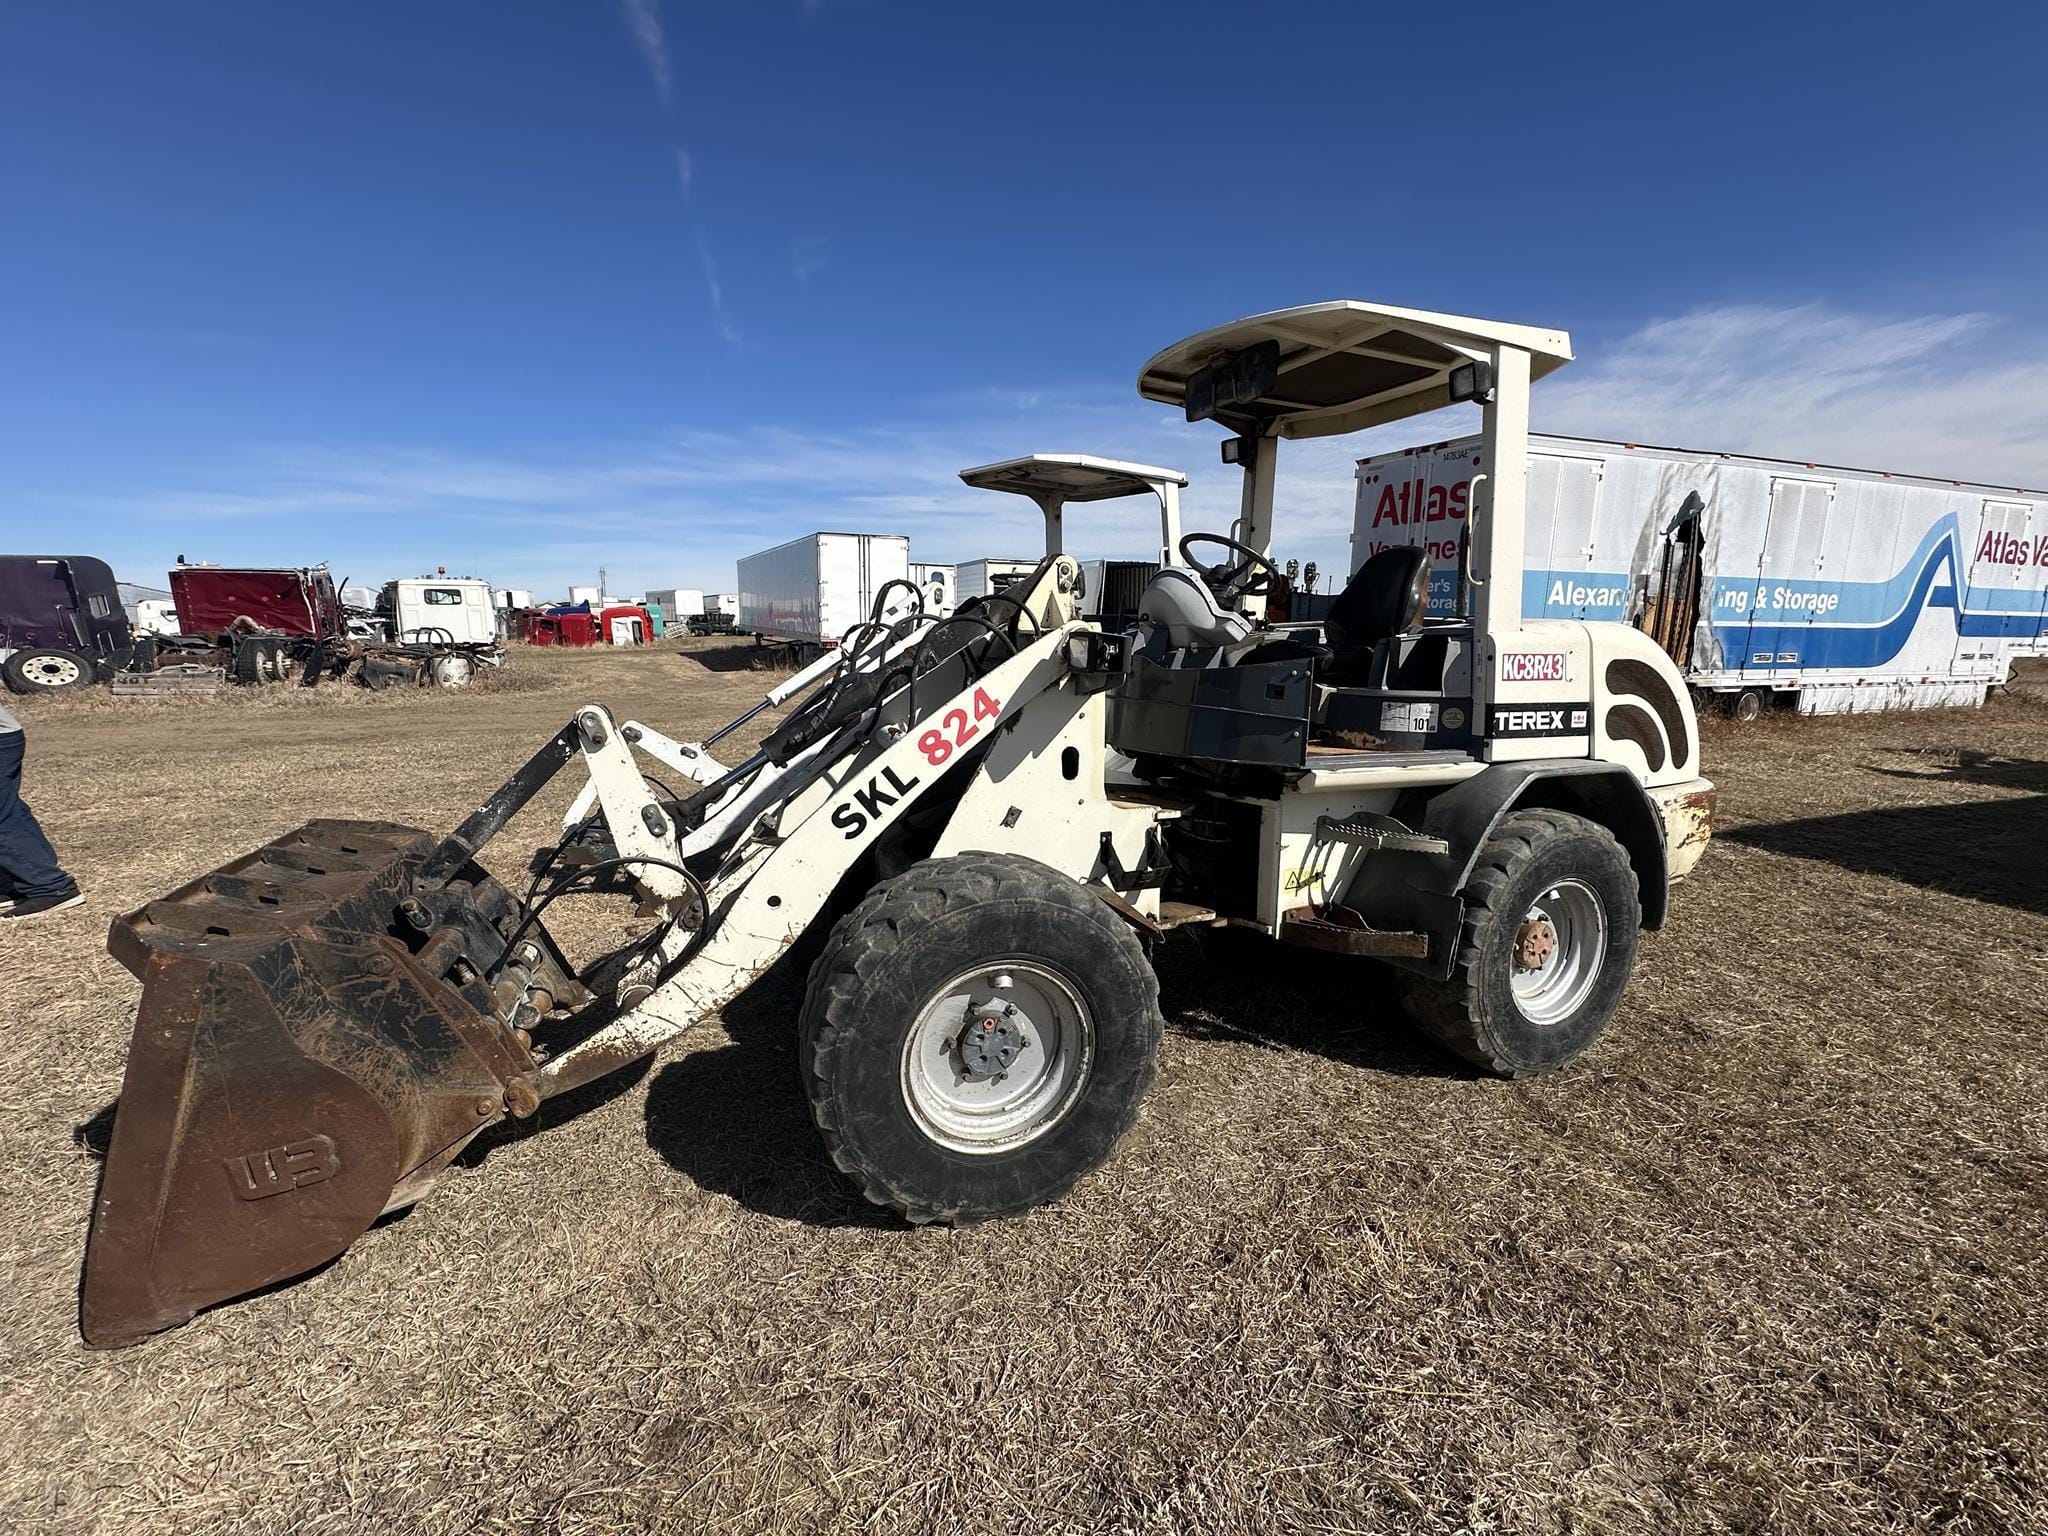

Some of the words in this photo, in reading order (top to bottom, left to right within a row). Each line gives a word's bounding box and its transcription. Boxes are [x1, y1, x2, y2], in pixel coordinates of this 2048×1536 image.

[1372, 479, 1470, 528] Atlas
[1976, 530, 2030, 566] Atlas
[1754, 586, 1768, 609] &
[1772, 586, 1839, 614] Storage
[1503, 654, 1564, 680] KC8R43
[918, 687, 1001, 766] 824
[1413, 718, 1430, 731] 101
[1494, 711, 1565, 731] TEREX
[831, 766, 920, 840] SKL
